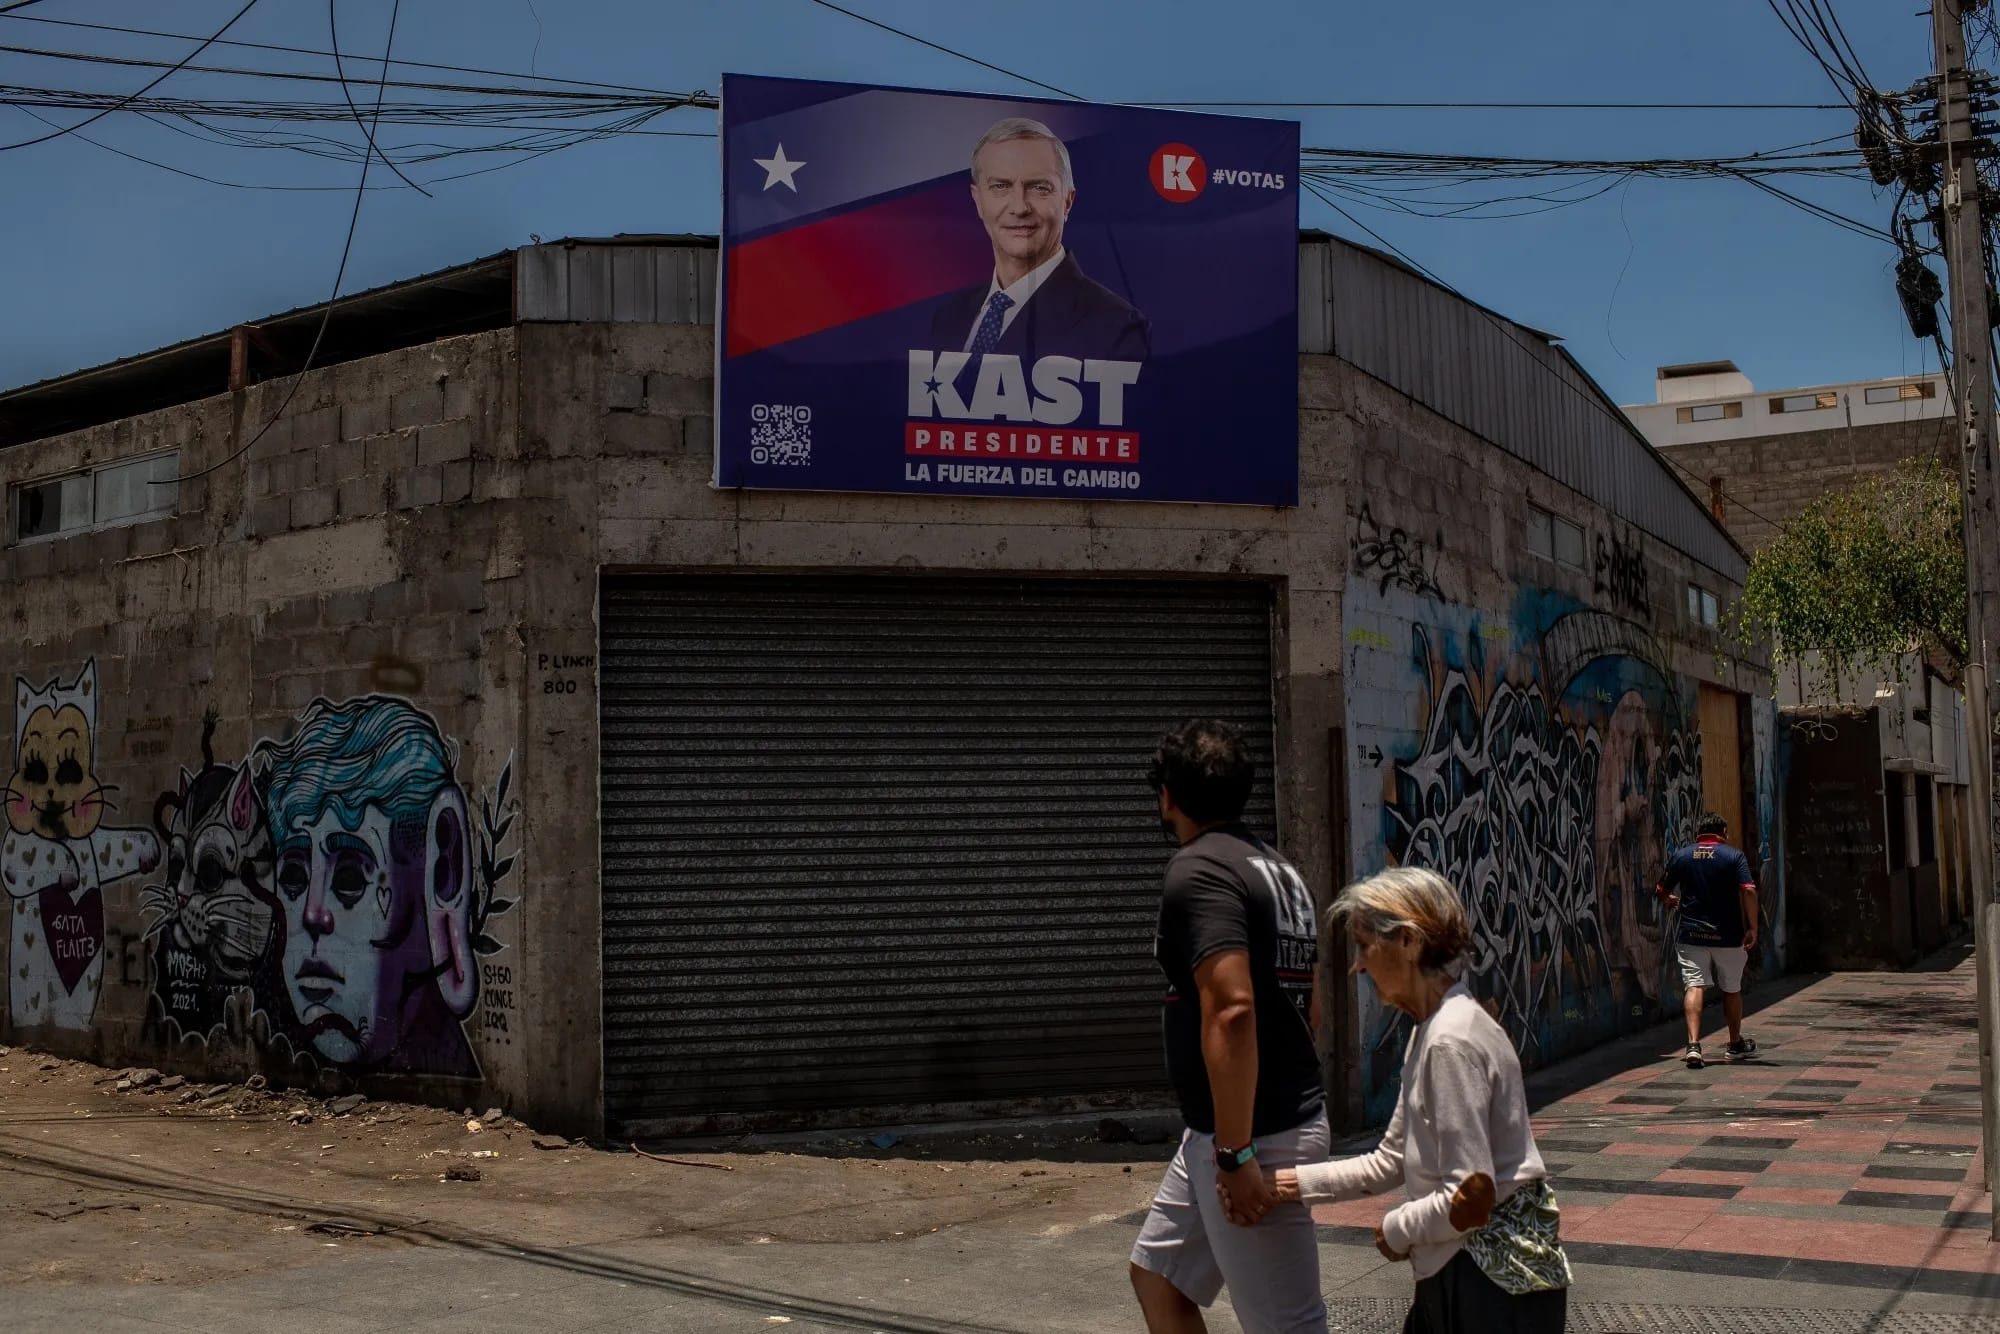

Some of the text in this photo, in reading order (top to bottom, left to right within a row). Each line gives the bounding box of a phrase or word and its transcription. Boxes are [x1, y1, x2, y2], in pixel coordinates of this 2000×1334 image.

[1162, 154, 1286, 192] K #VOTA5
[907, 349, 1143, 427] KAST
[914, 429, 1131, 458] PRESIDENTE
[905, 462, 1141, 490] LA FUERZA DEL CAMBIO
[538, 654, 594, 671] P. LYNCH
[543, 679, 577, 695] 800
